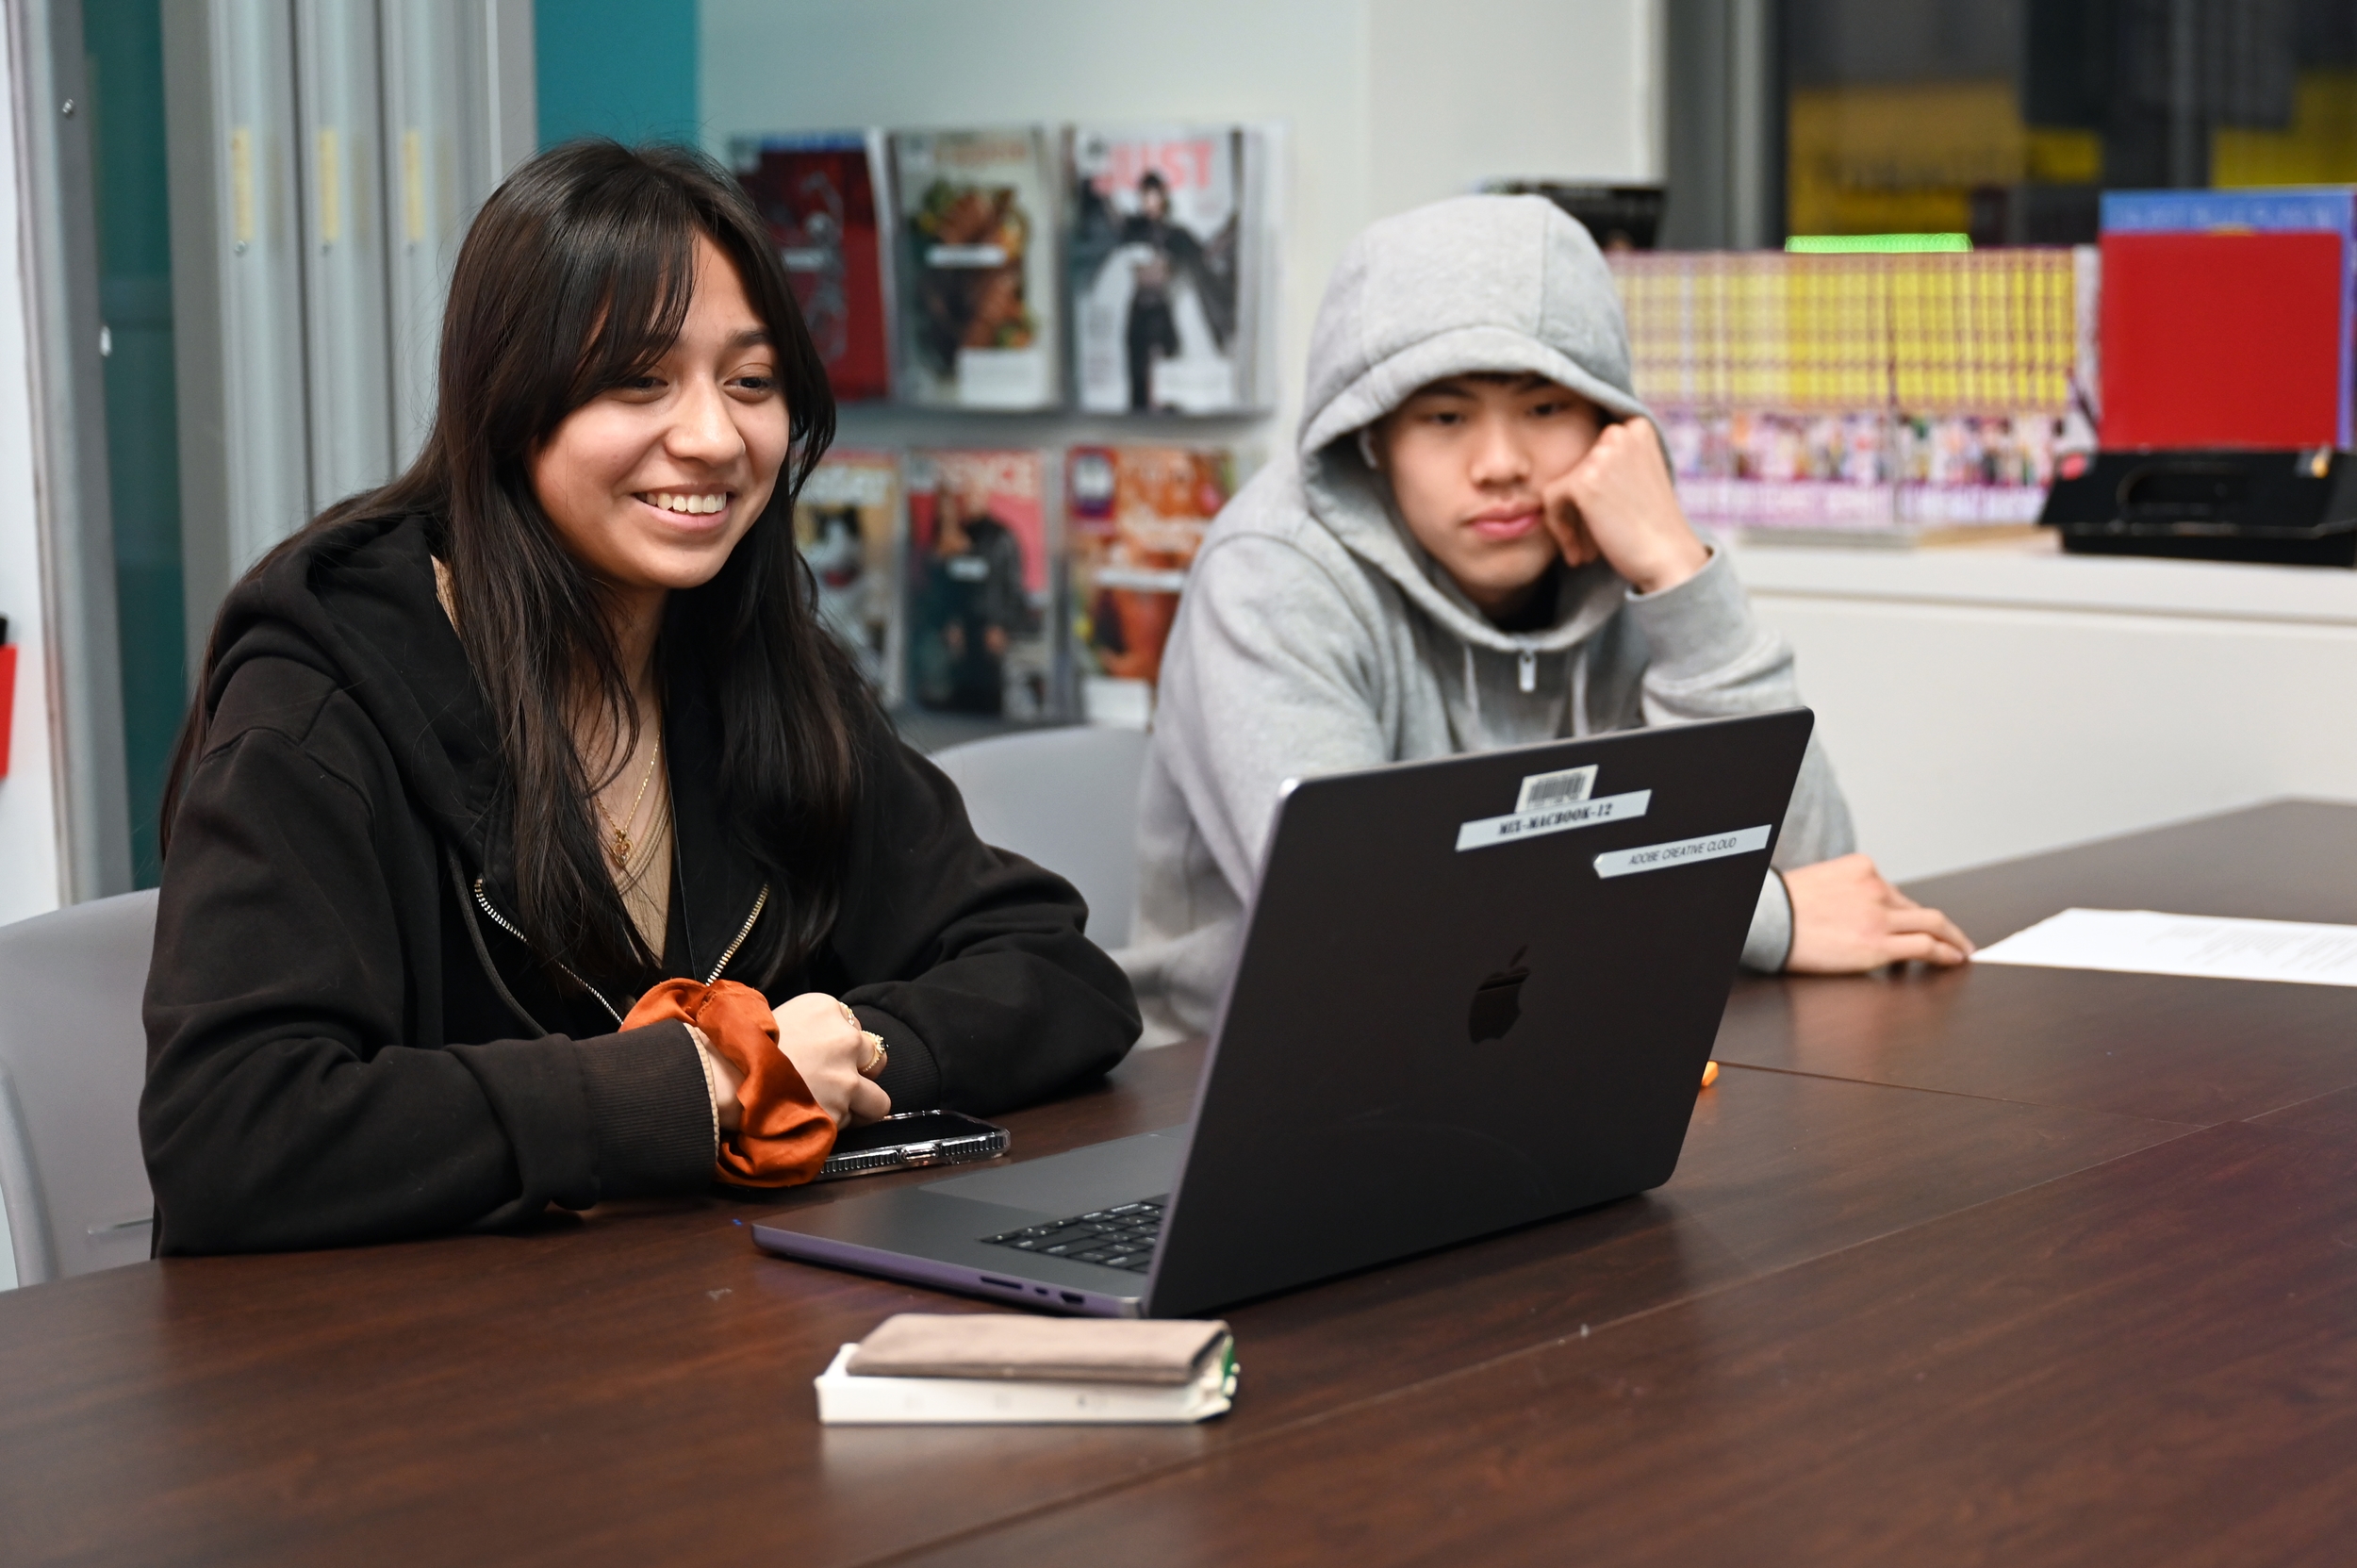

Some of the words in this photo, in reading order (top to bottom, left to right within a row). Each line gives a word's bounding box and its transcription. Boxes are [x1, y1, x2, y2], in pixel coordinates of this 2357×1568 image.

[1628, 850, 1660, 866] ADOBE
[1661, 843, 1706, 861] CREATIVE
[1706, 836, 1738, 853] CLOUD
